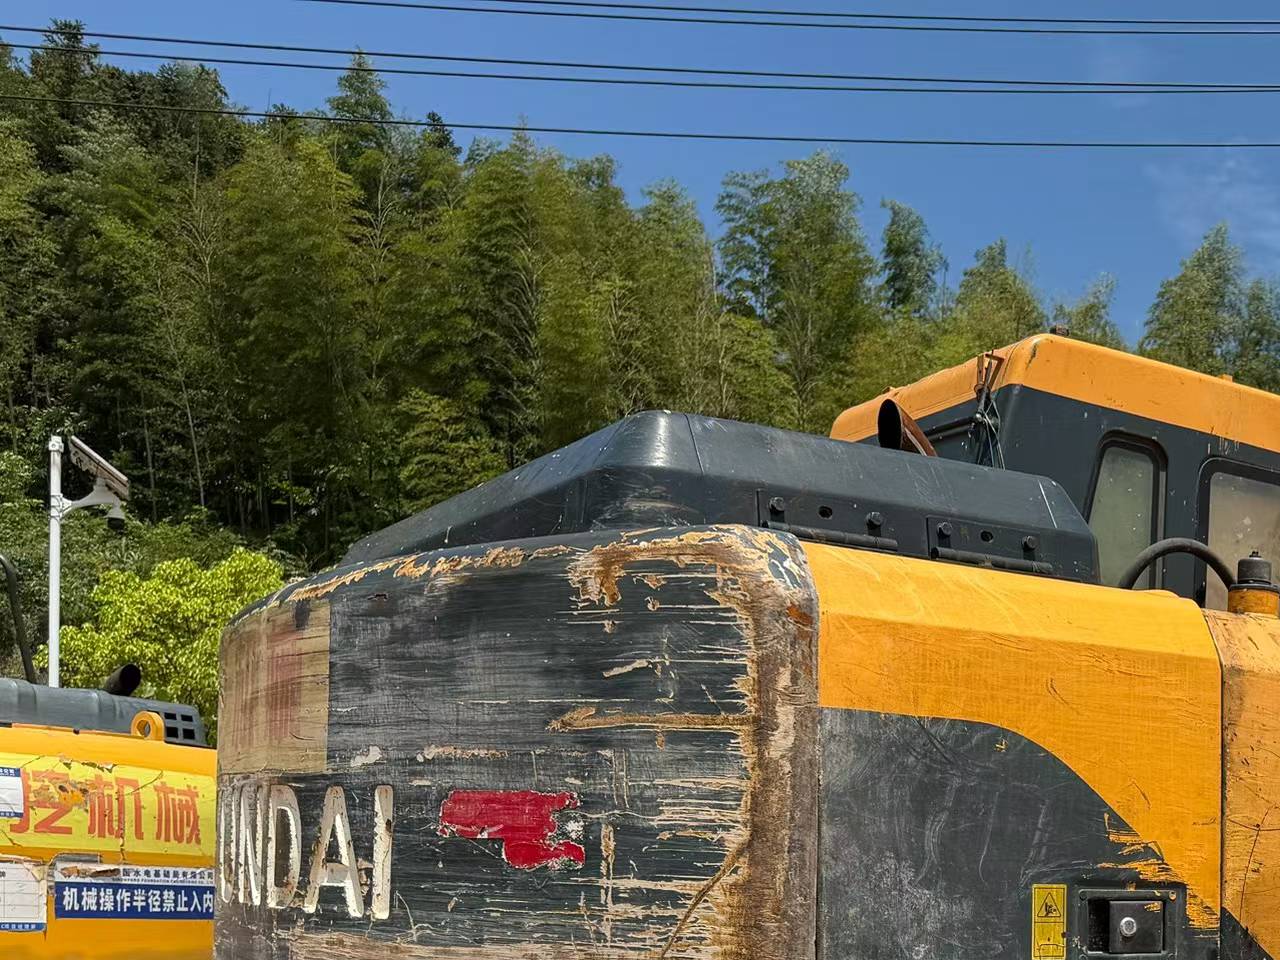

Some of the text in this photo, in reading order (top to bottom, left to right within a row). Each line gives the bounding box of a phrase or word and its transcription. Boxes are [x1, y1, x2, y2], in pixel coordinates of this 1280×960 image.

[63, 887, 214, 914] 机械操作半径禁止入内
